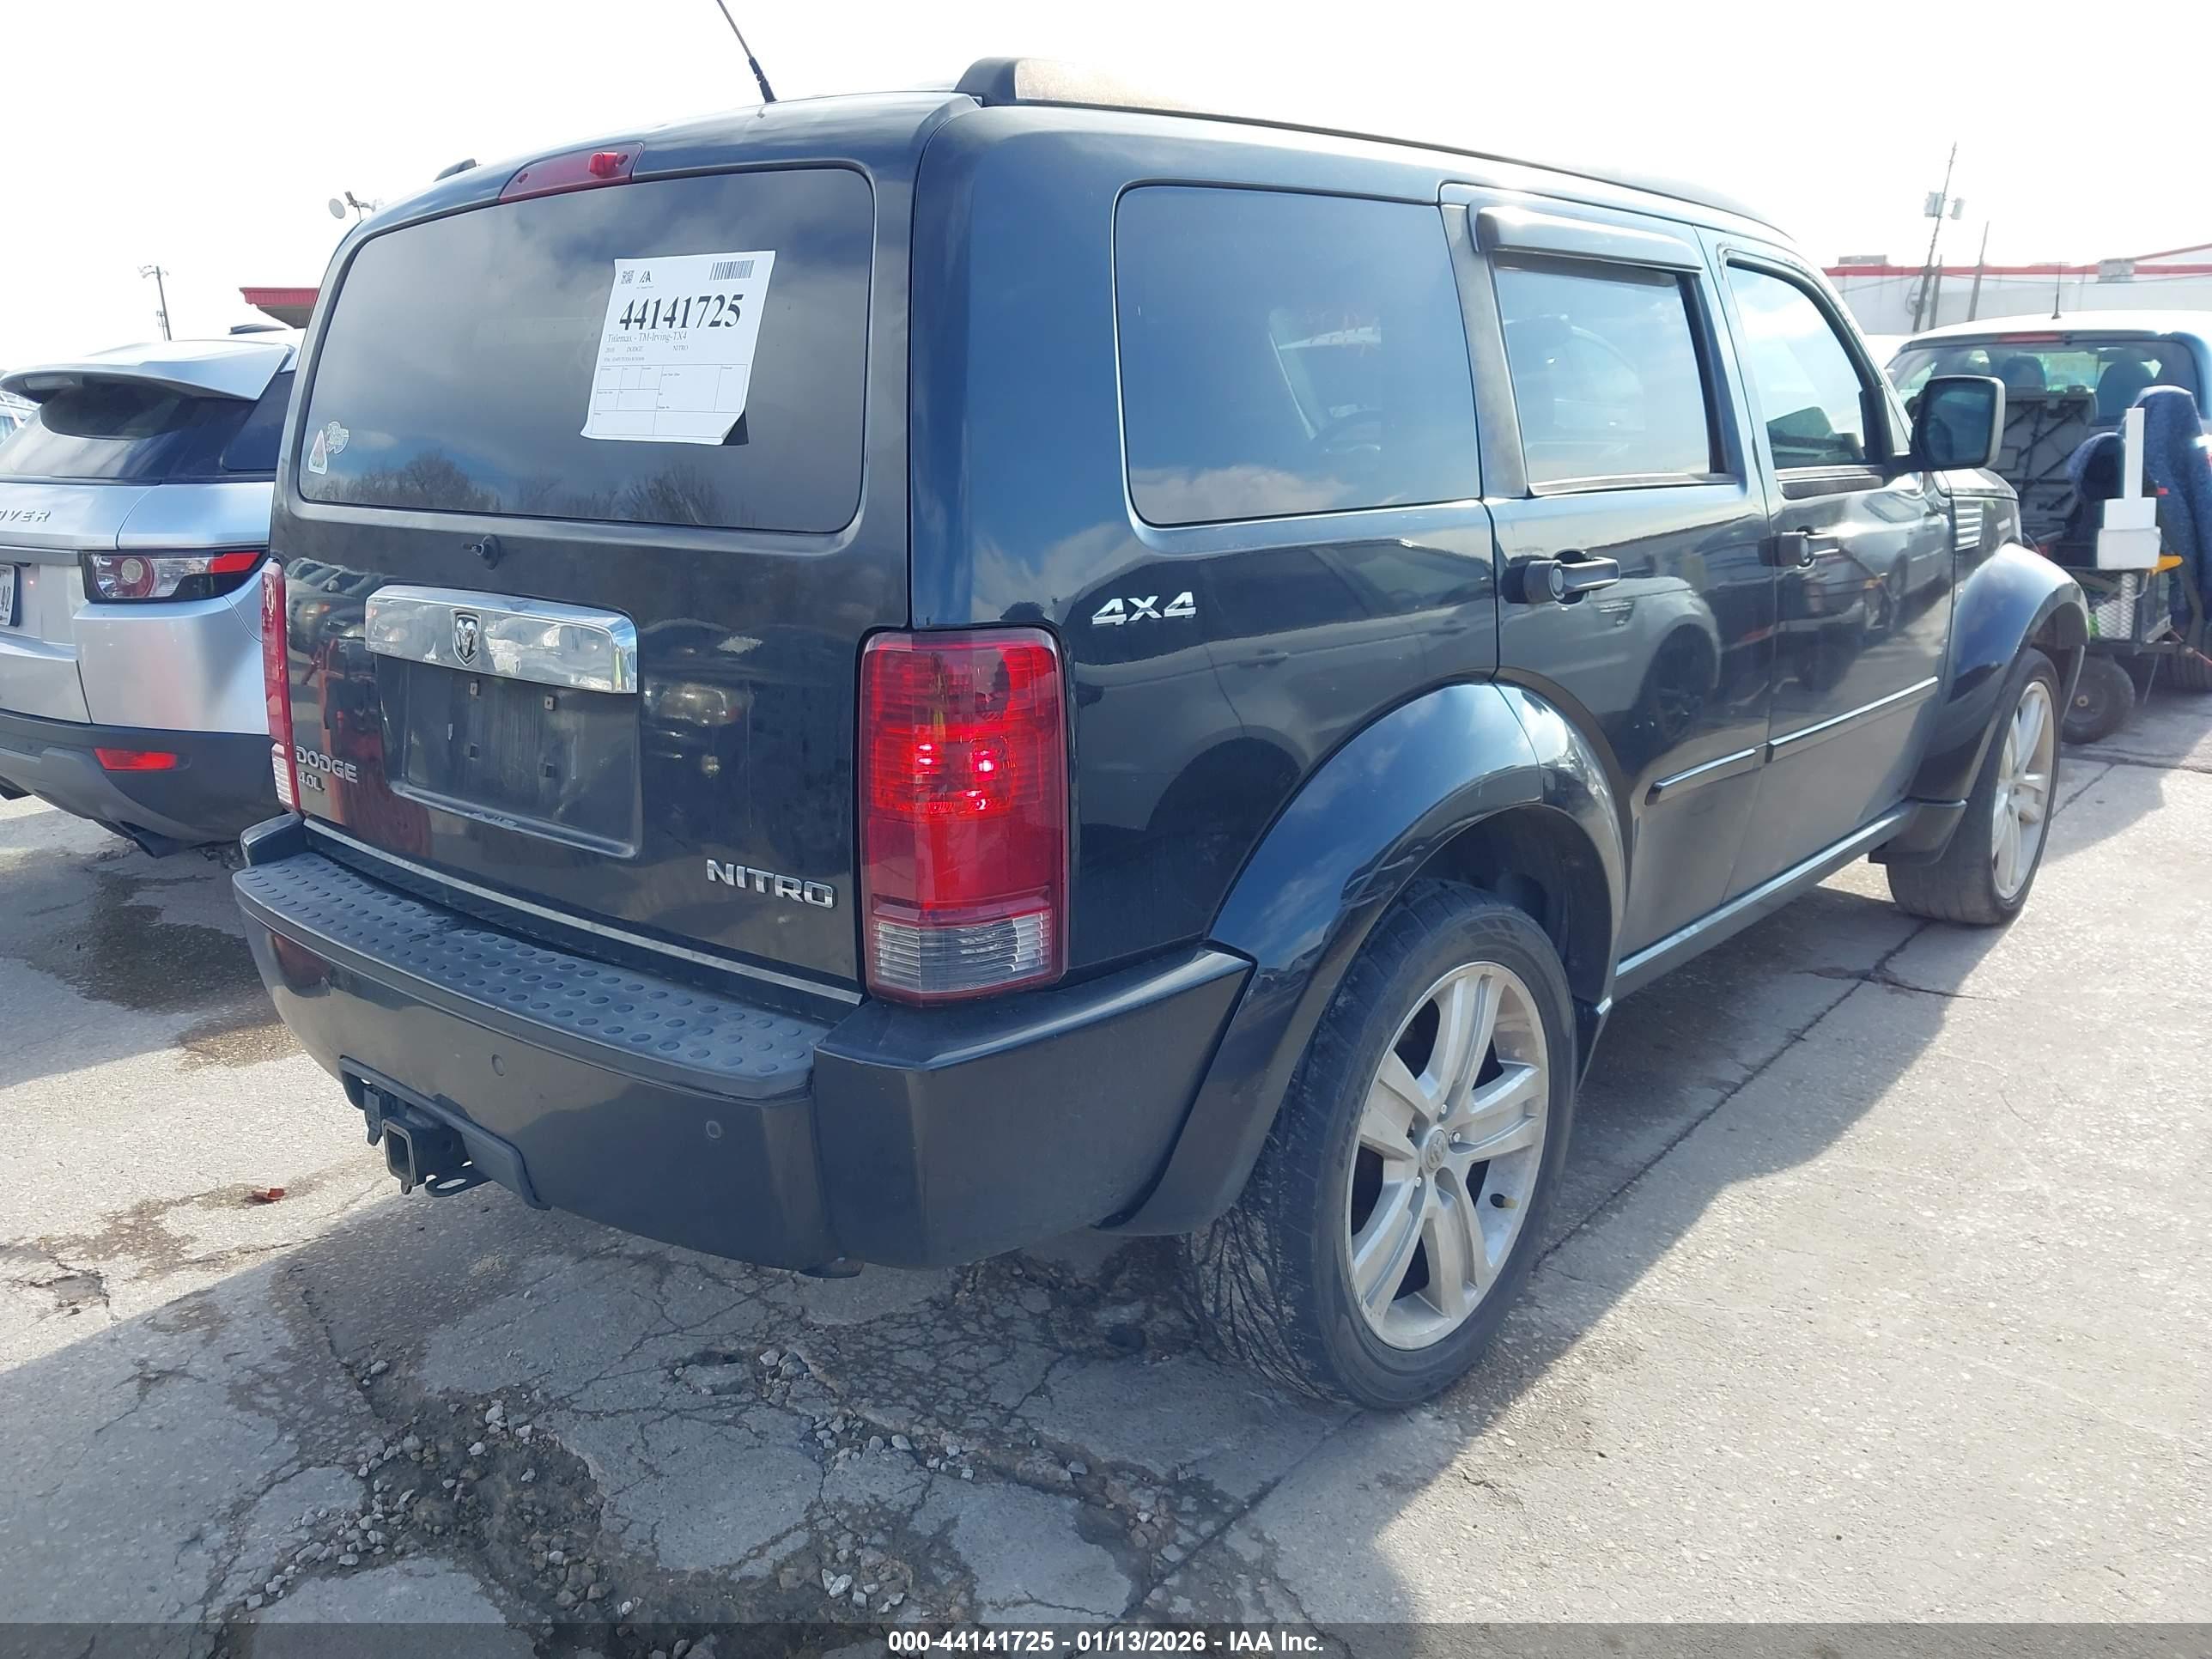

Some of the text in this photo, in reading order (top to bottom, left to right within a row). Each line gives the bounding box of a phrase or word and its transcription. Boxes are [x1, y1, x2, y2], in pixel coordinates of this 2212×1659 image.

[619, 294, 744, 331] 44141725
[295, 745, 358, 783] DODGE
[706, 859, 835, 909] NITRO
